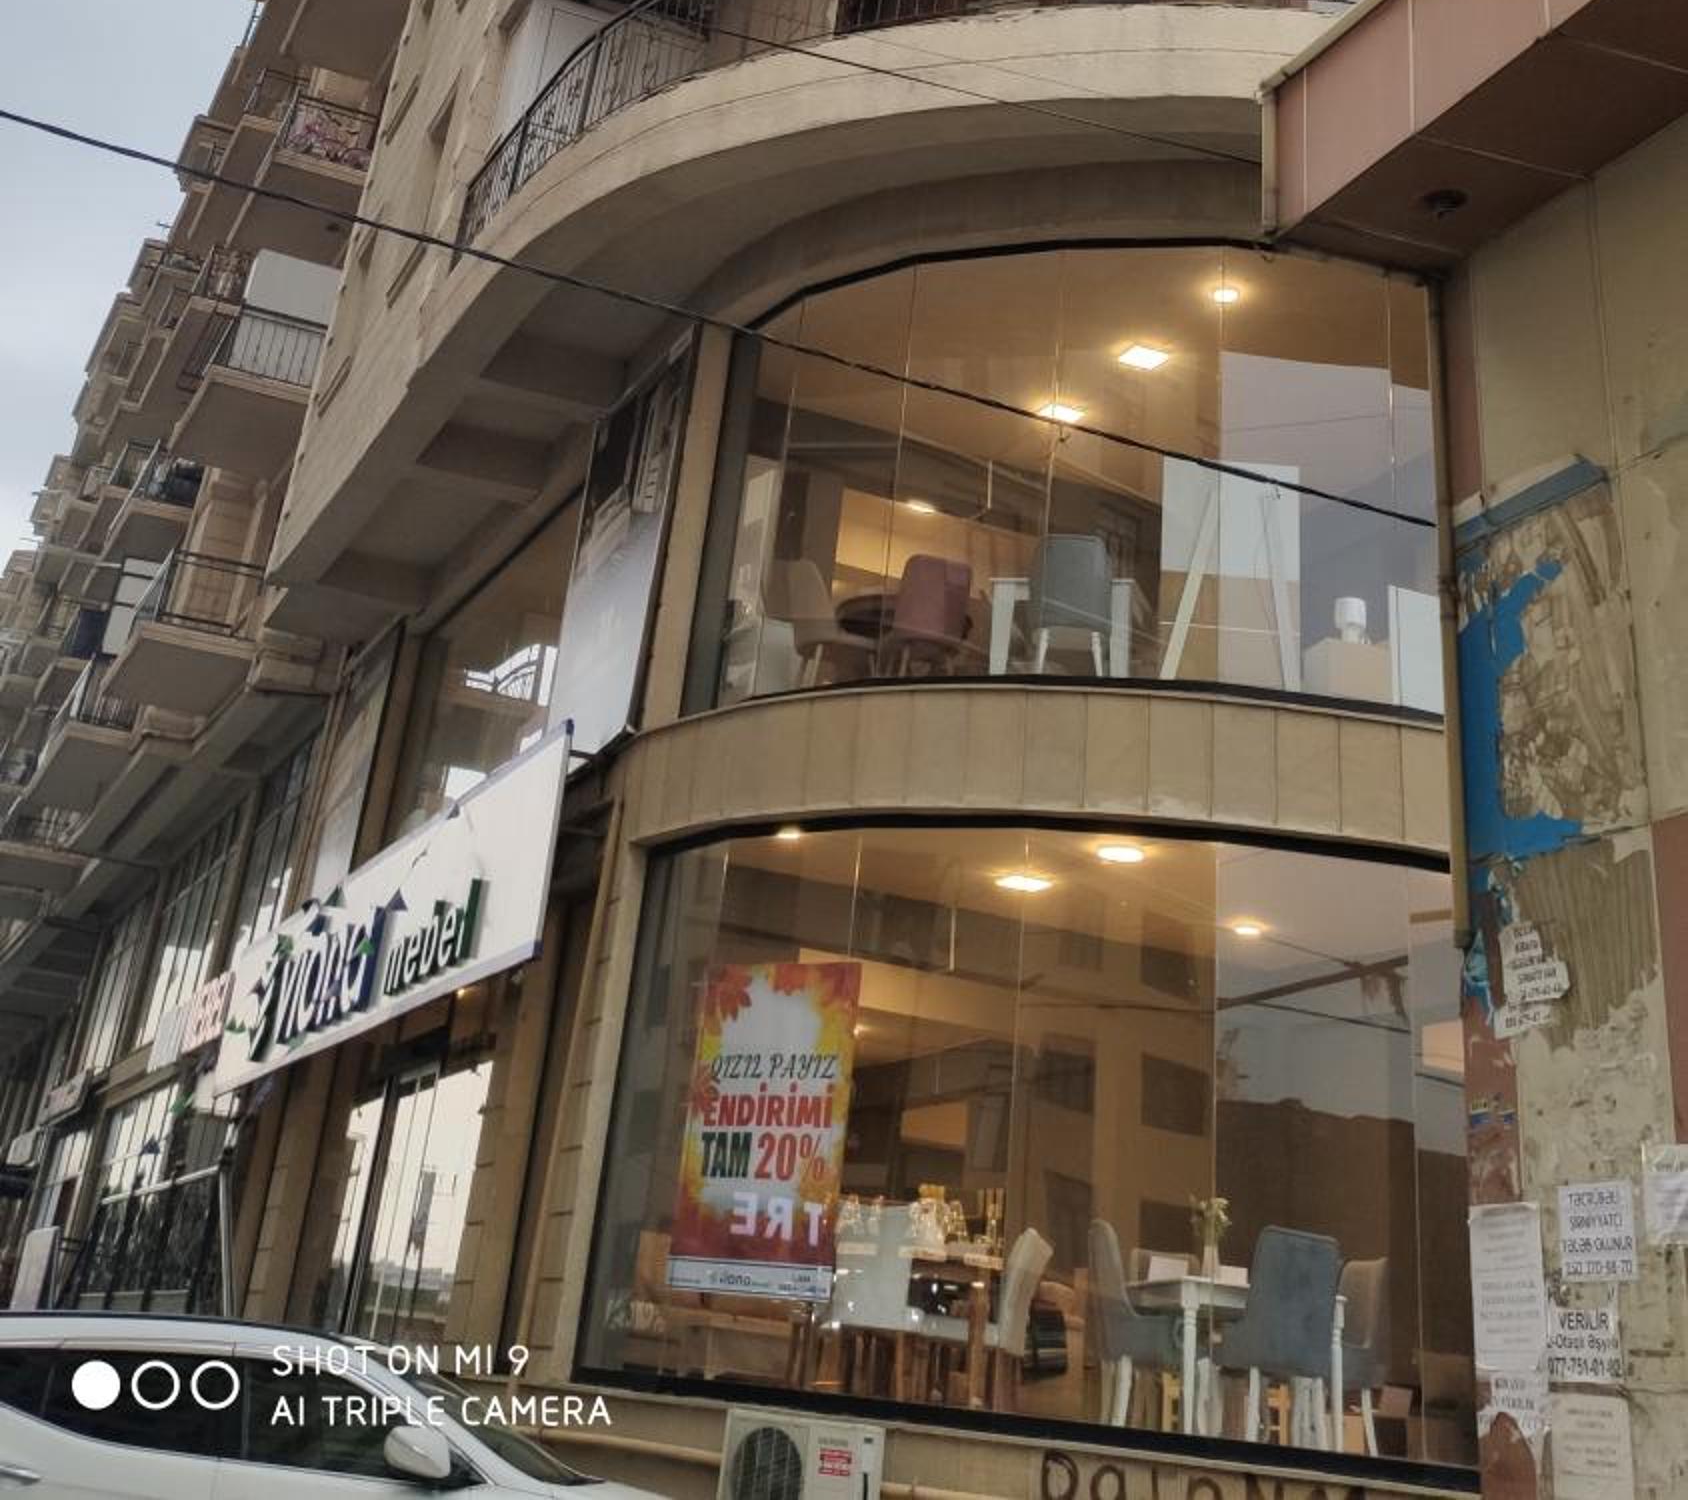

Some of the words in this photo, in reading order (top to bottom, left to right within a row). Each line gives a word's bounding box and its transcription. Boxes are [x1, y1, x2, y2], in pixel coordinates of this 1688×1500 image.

[383, 879, 482, 996] mebel
[711, 1053, 762, 1083] QIZIL
[768, 1053, 838, 1079] PAYIZ
[701, 1131, 752, 1179] TAM
[754, 1132, 825, 1181] 20%
